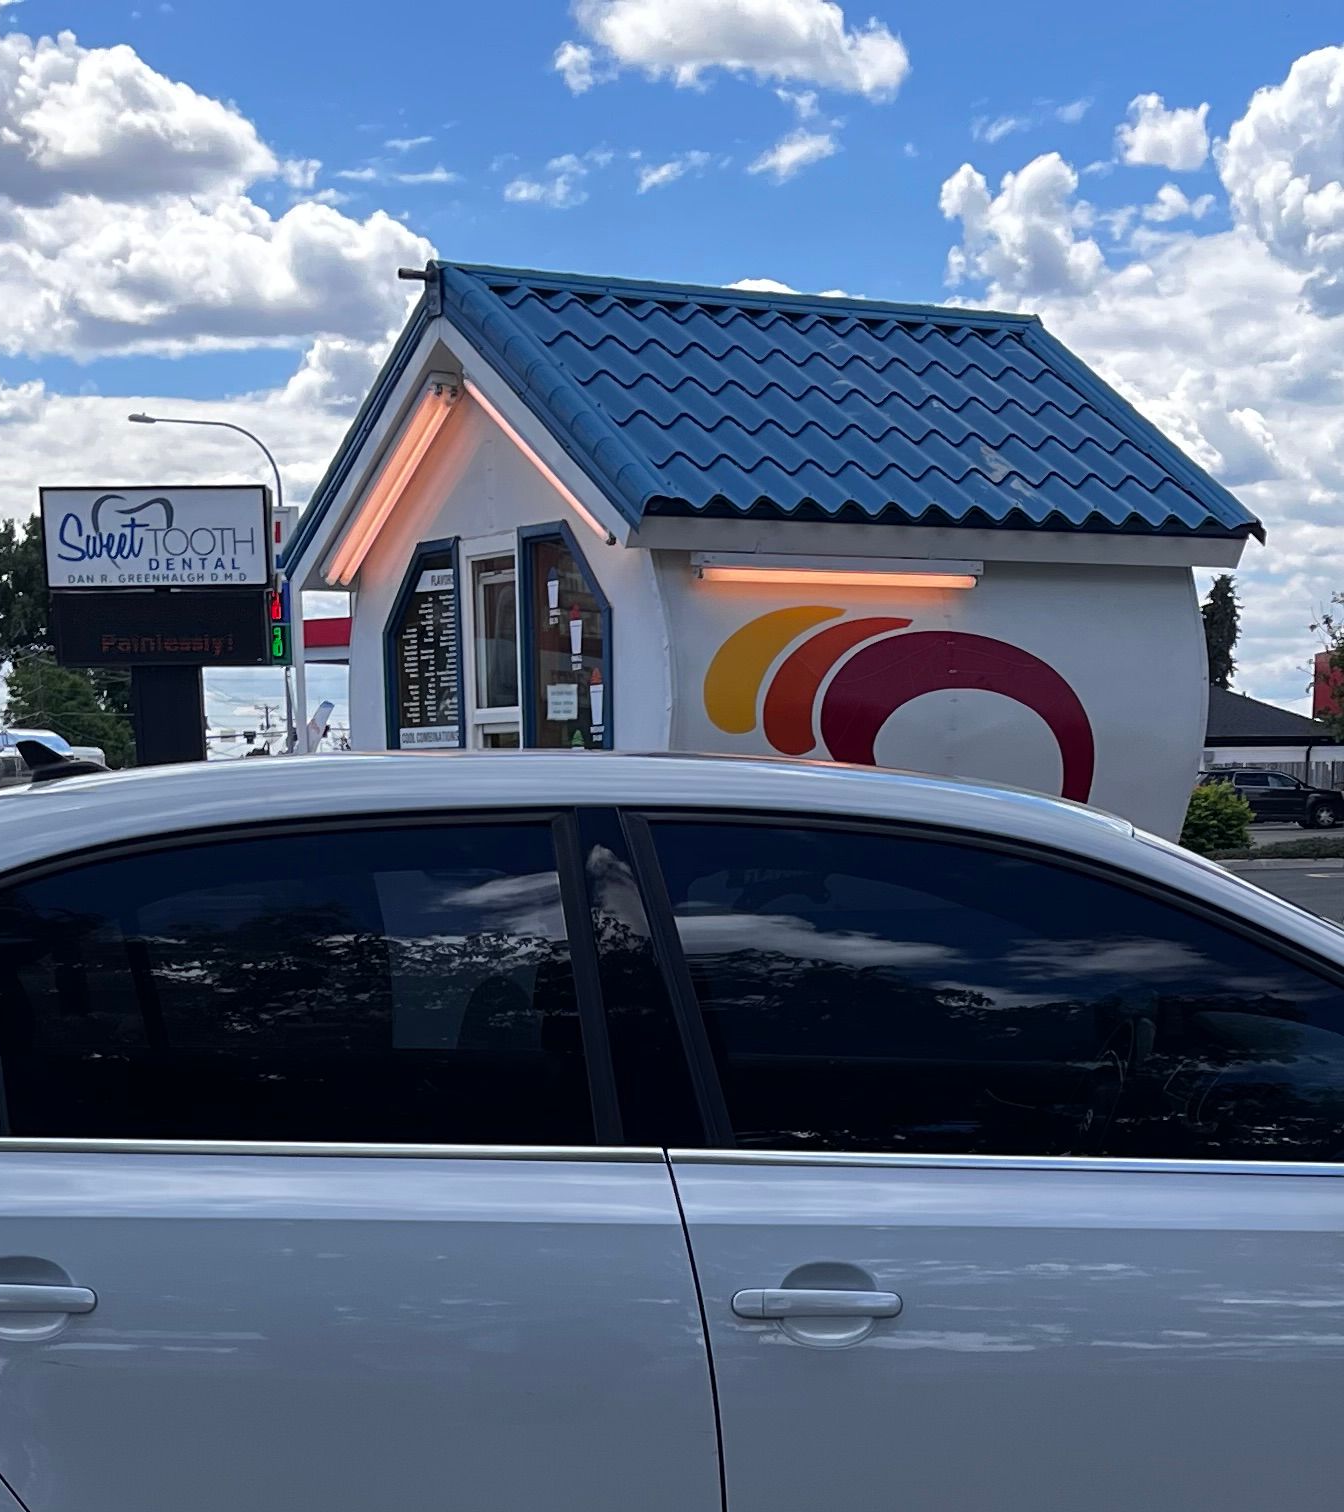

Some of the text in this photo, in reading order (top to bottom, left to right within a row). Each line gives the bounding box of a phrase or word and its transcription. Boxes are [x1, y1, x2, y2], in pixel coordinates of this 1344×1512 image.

[57, 512, 255, 562] Sweet TOOTH
[148, 557, 240, 571] DENTAL
[67, 574, 95, 584] DAN
[118, 573, 205, 584] GREENHALGH
